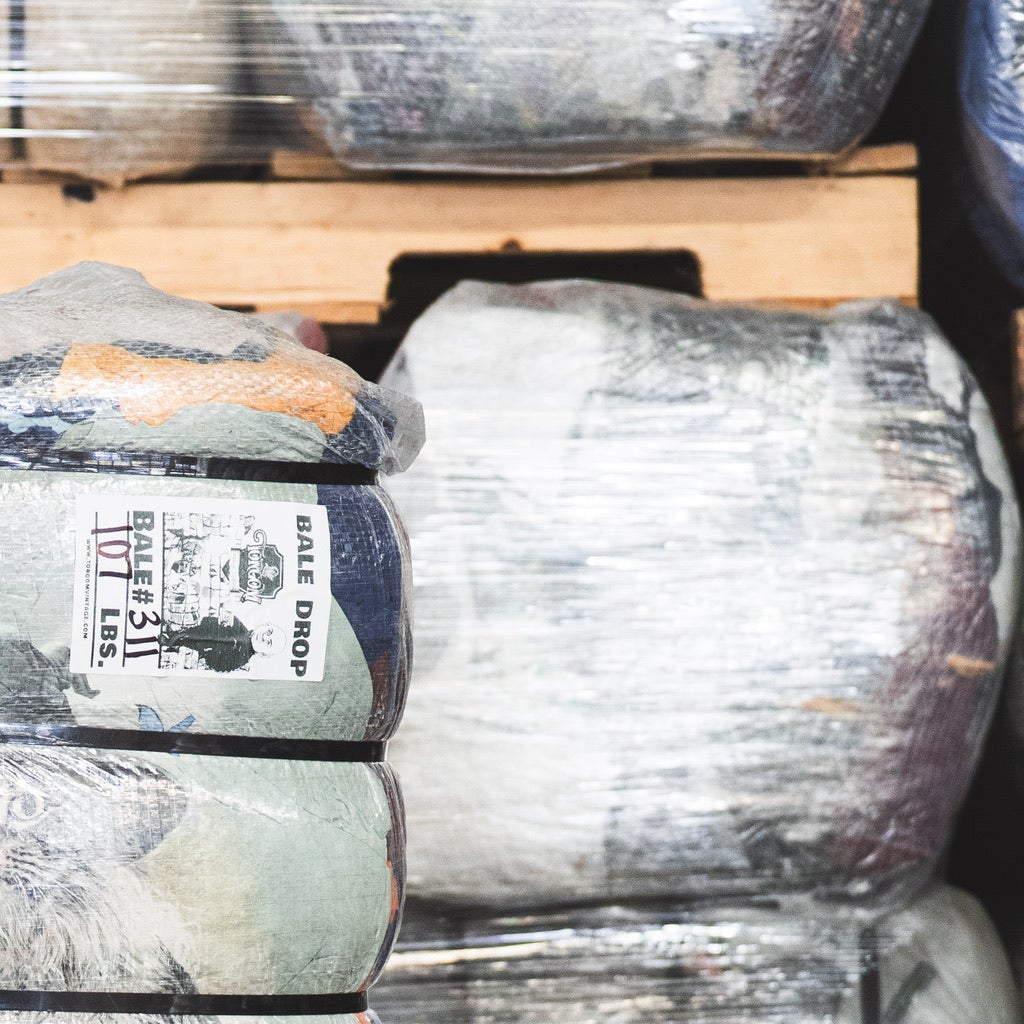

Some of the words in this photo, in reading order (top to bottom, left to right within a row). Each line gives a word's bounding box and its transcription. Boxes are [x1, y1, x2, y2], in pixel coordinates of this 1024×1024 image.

[296, 514, 315, 586] BALE
[97, 608, 121, 668] LBS.
[290, 600, 314, 678] DROP
